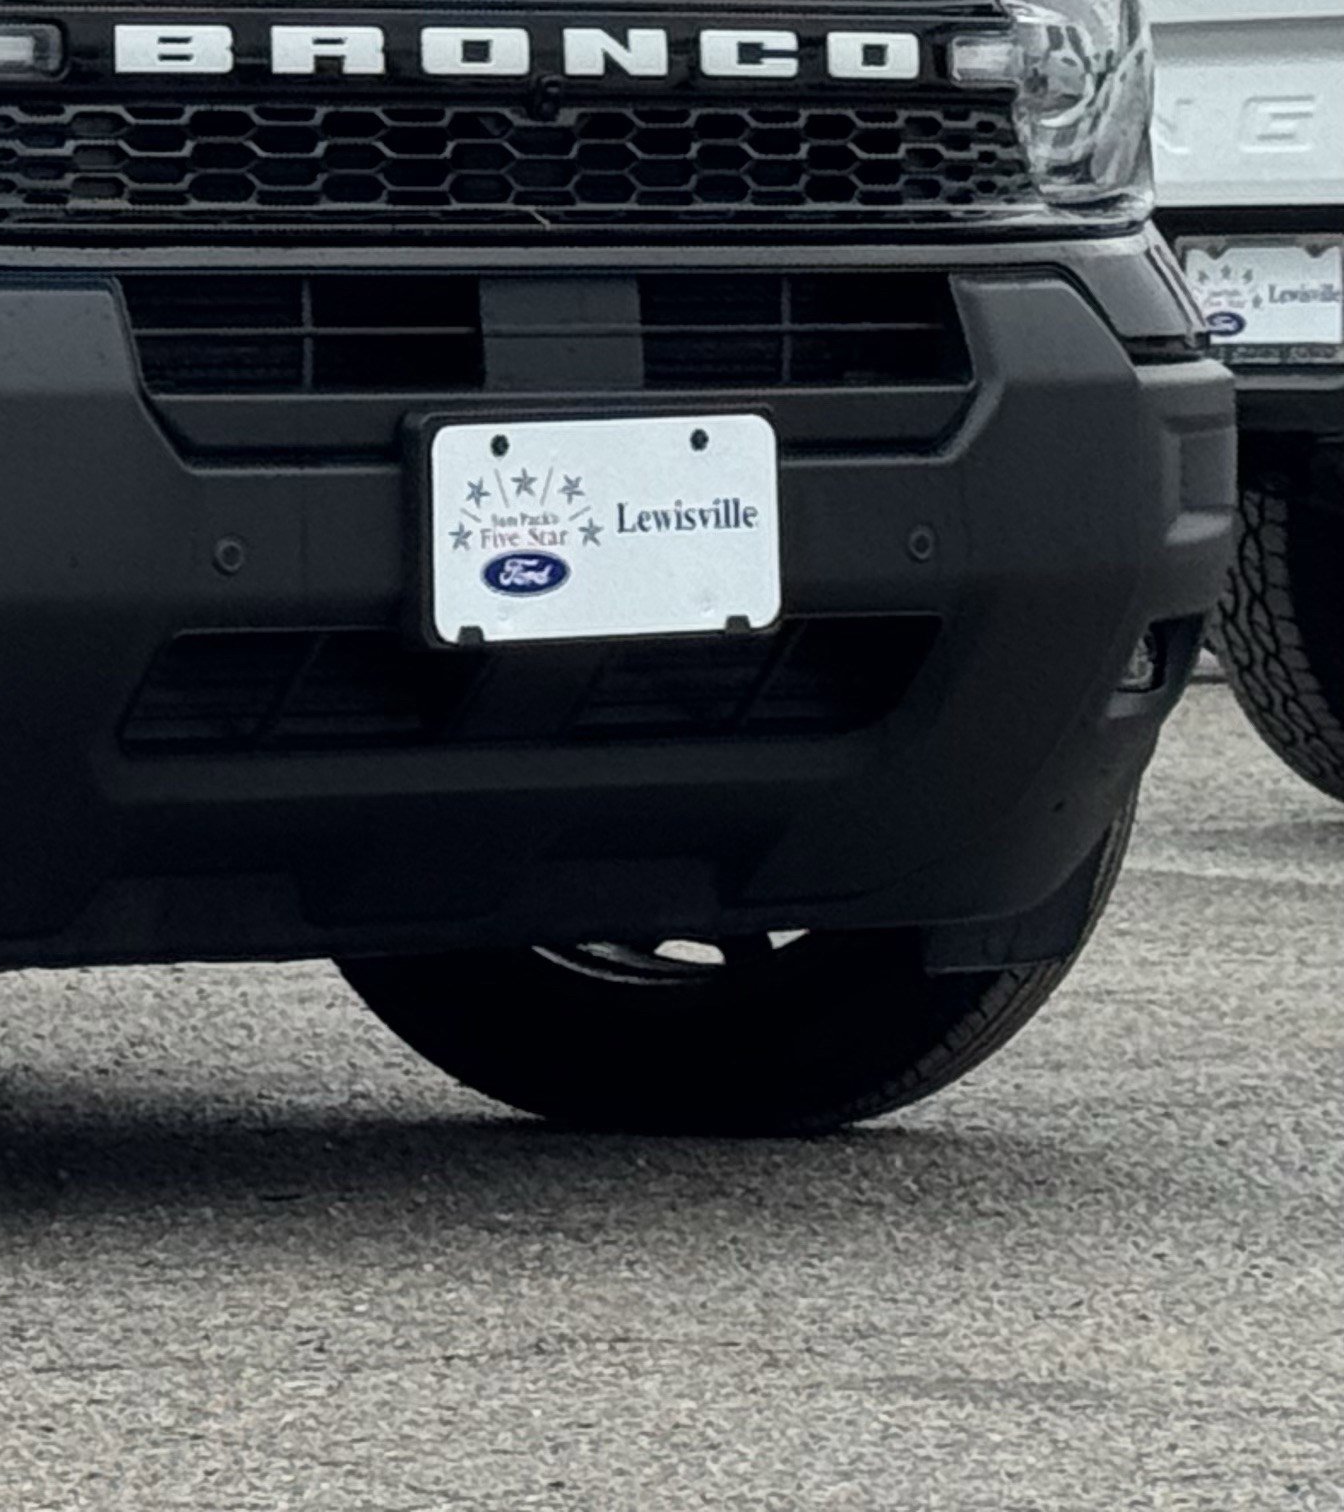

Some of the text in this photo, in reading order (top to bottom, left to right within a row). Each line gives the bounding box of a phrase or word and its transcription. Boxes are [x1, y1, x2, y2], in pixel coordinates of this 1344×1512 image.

[114, 25, 920, 79] BRONCO
[616, 497, 759, 534] Lewisville
[480, 527, 569, 549] Five Star
[500, 558, 553, 586] Ford
